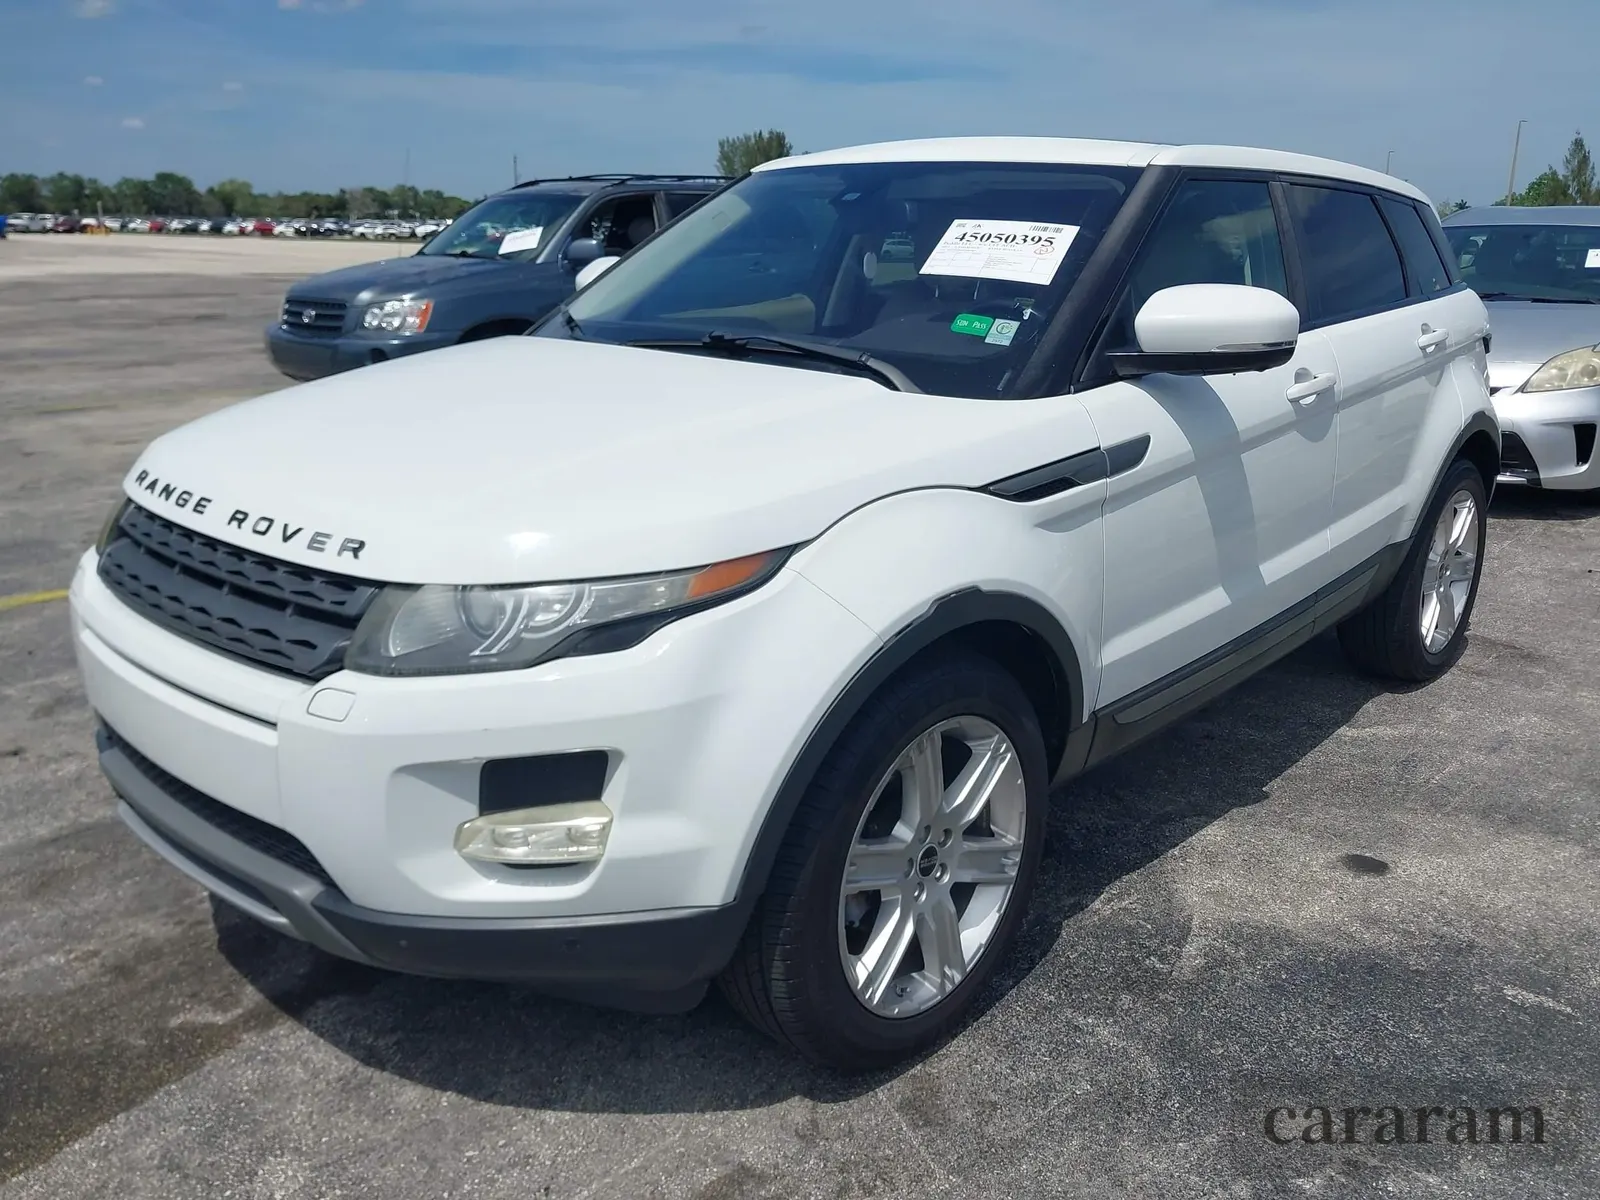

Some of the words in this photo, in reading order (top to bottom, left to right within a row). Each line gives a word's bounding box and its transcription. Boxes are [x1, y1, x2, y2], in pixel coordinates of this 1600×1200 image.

[955, 232, 1056, 247] 45050395
[135, 470, 212, 515] RANGE
[227, 509, 366, 560] ROVER
